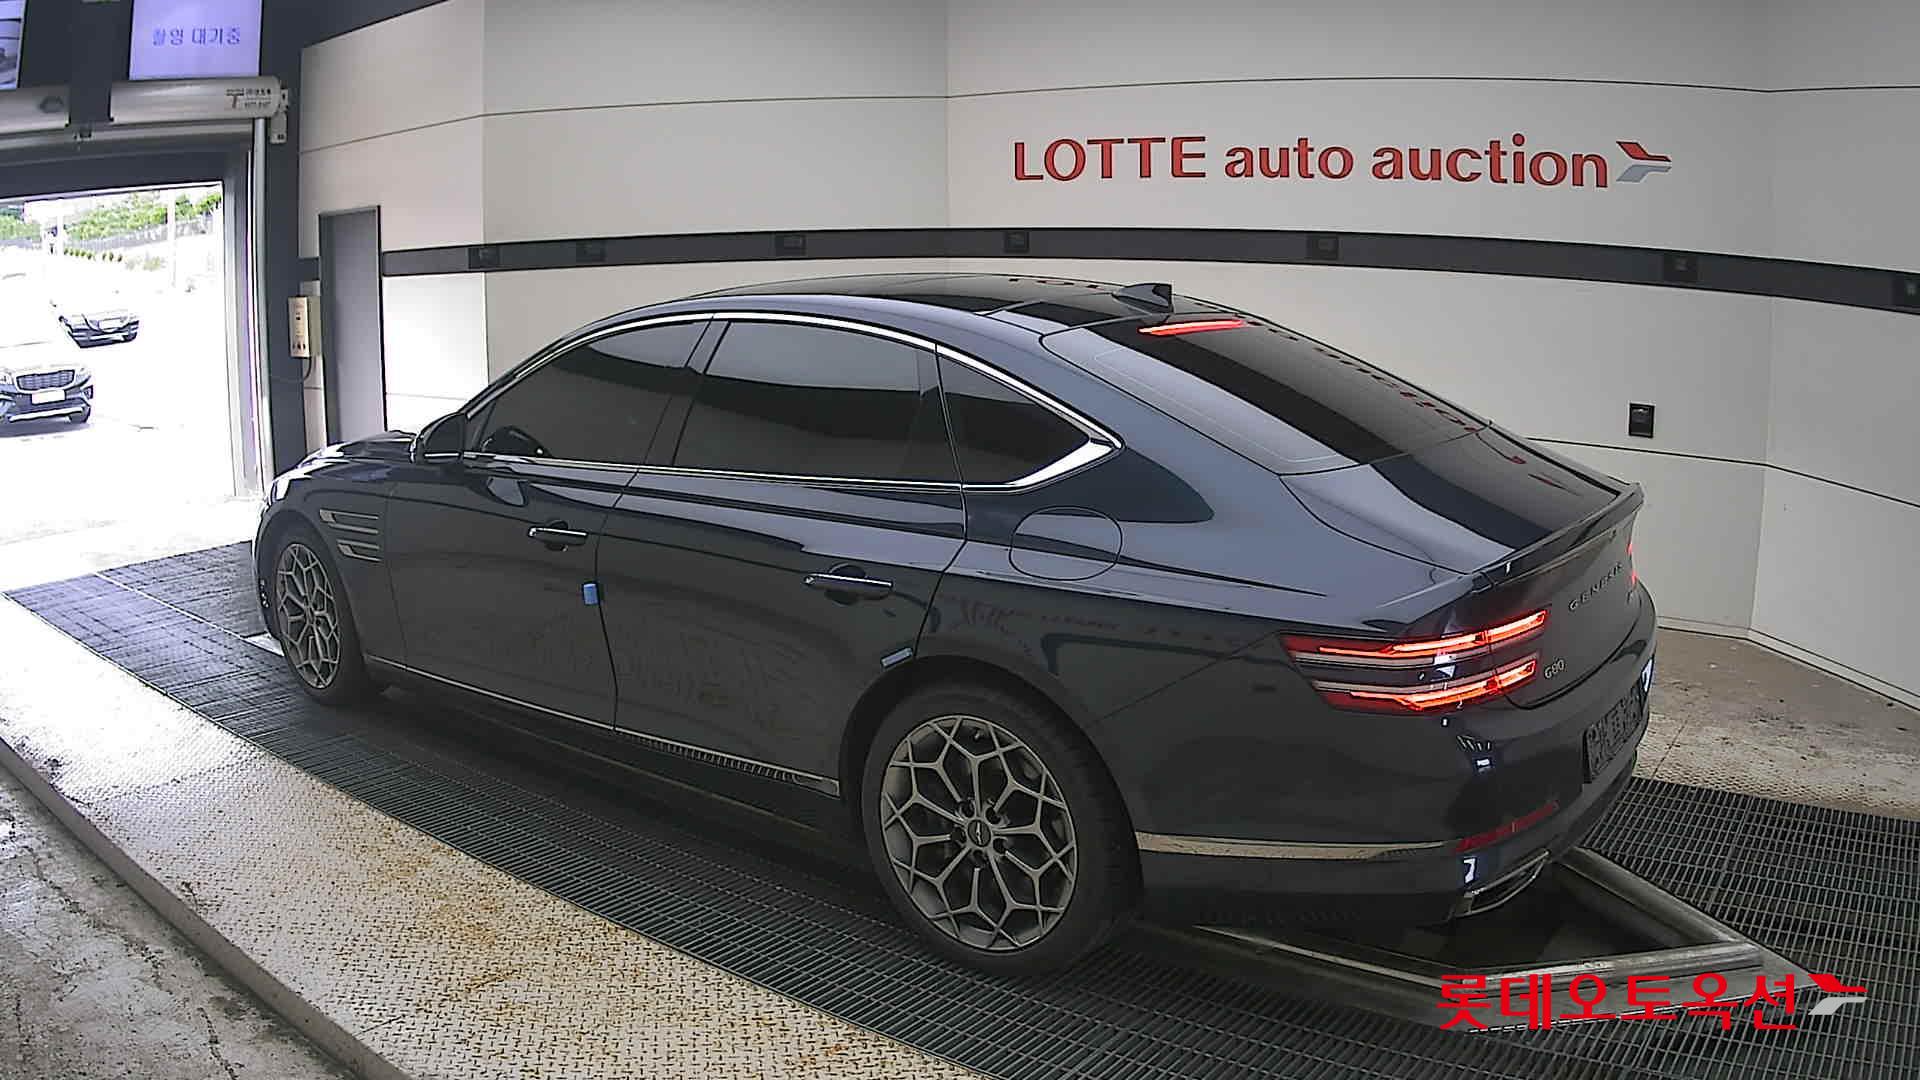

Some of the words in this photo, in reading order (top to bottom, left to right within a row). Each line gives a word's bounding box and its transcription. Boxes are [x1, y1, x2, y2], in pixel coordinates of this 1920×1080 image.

[191, 26, 241, 45] 대기중
[1014, 136, 1206, 182] LOTTE
[1223, 137, 1354, 180] auto
[1371, 133, 1608, 188] auction
[1567, 561, 1623, 612] GENESIS
[1543, 657, 1565, 680] G80
